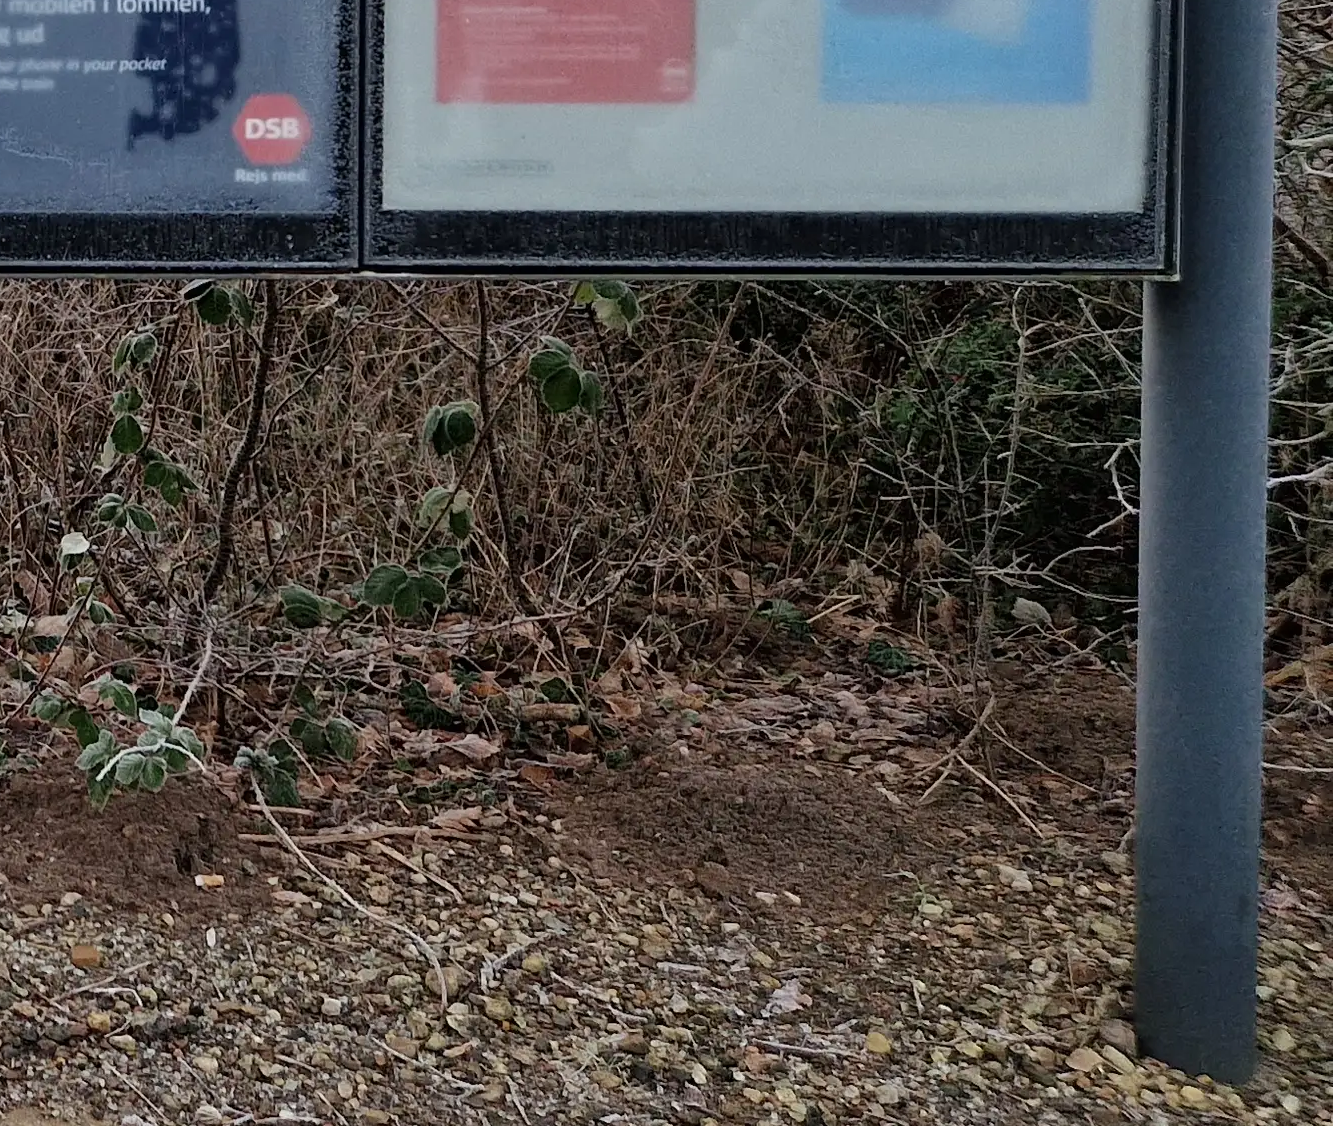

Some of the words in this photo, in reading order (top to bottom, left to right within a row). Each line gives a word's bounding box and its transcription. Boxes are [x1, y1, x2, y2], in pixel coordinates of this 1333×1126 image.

[15, 24, 44, 44] ud
[118, 58, 167, 74] pocket
[245, 118, 299, 140] DSB
[234, 168, 268, 185] Rejs
[272, 168, 308, 182] med
